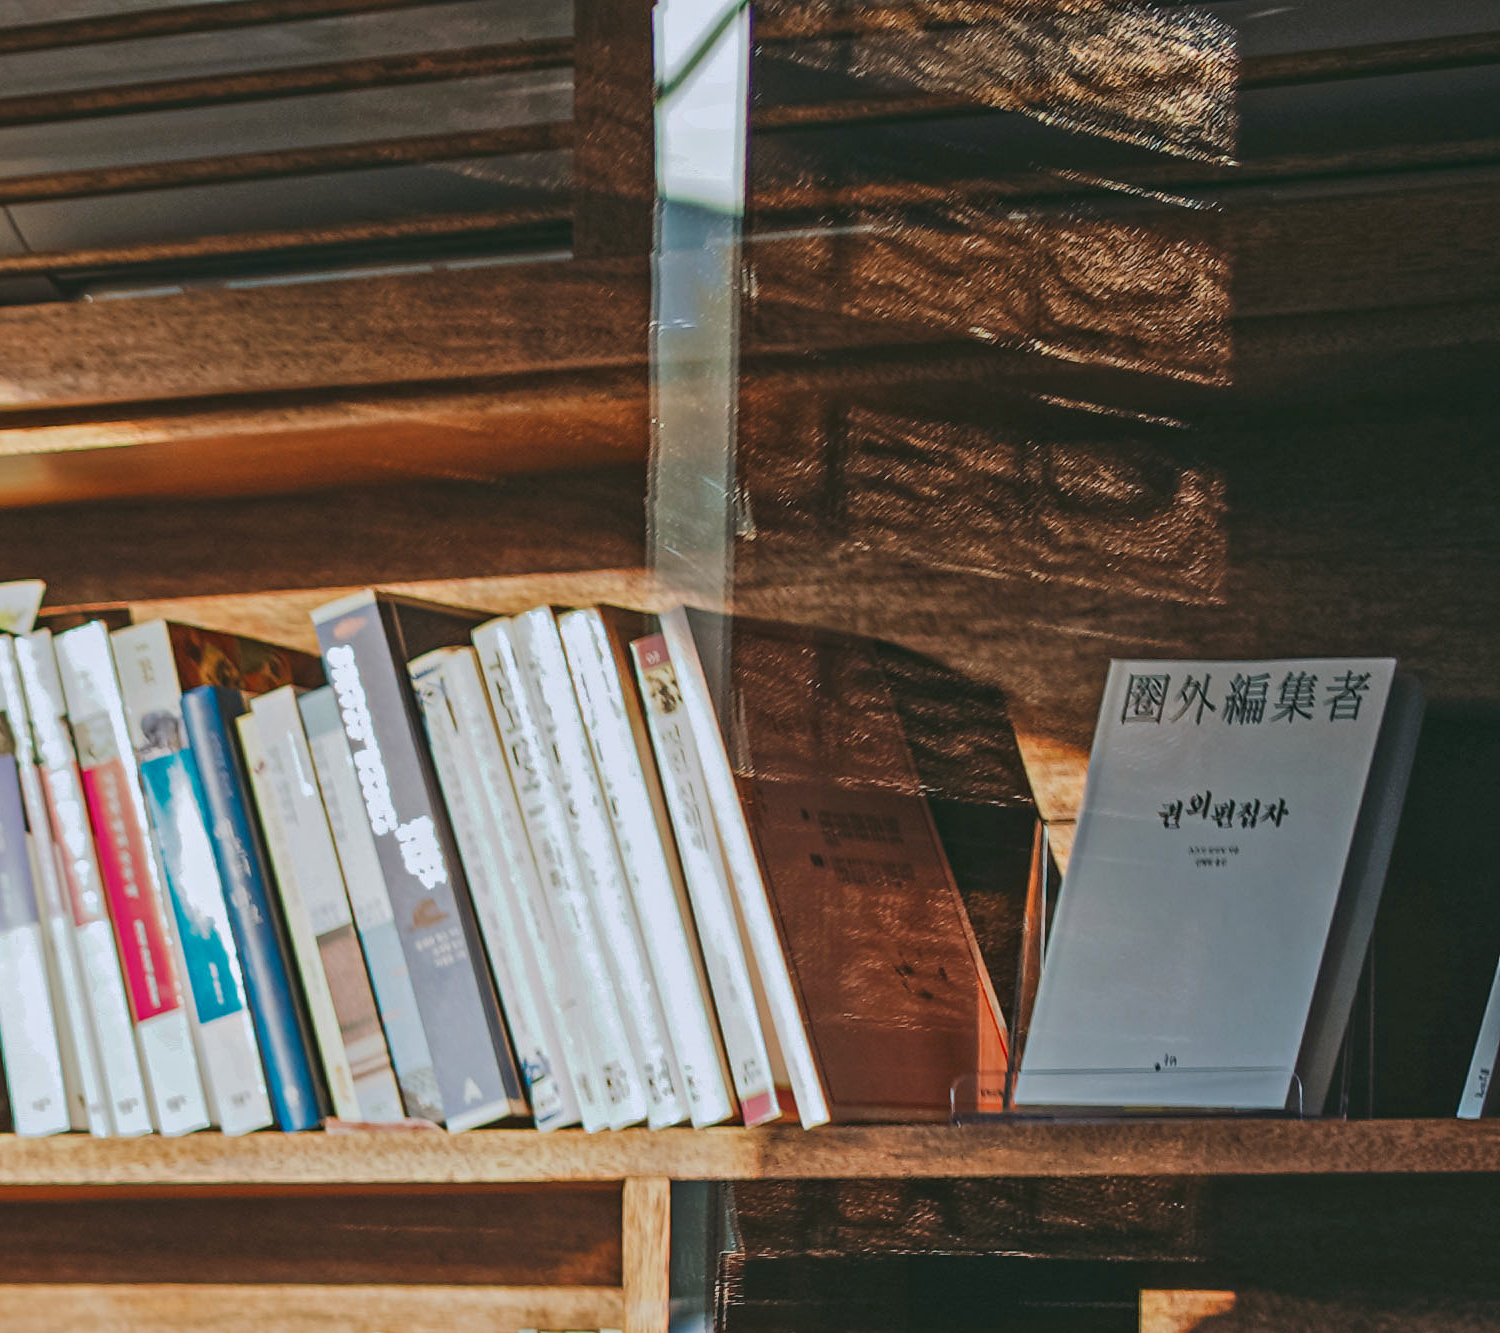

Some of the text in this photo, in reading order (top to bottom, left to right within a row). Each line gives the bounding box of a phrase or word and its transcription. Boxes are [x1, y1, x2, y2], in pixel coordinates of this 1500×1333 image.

[1121, 671, 1372, 726] 圈外編集者
[1158, 790, 1289, 829] 권외편집자
